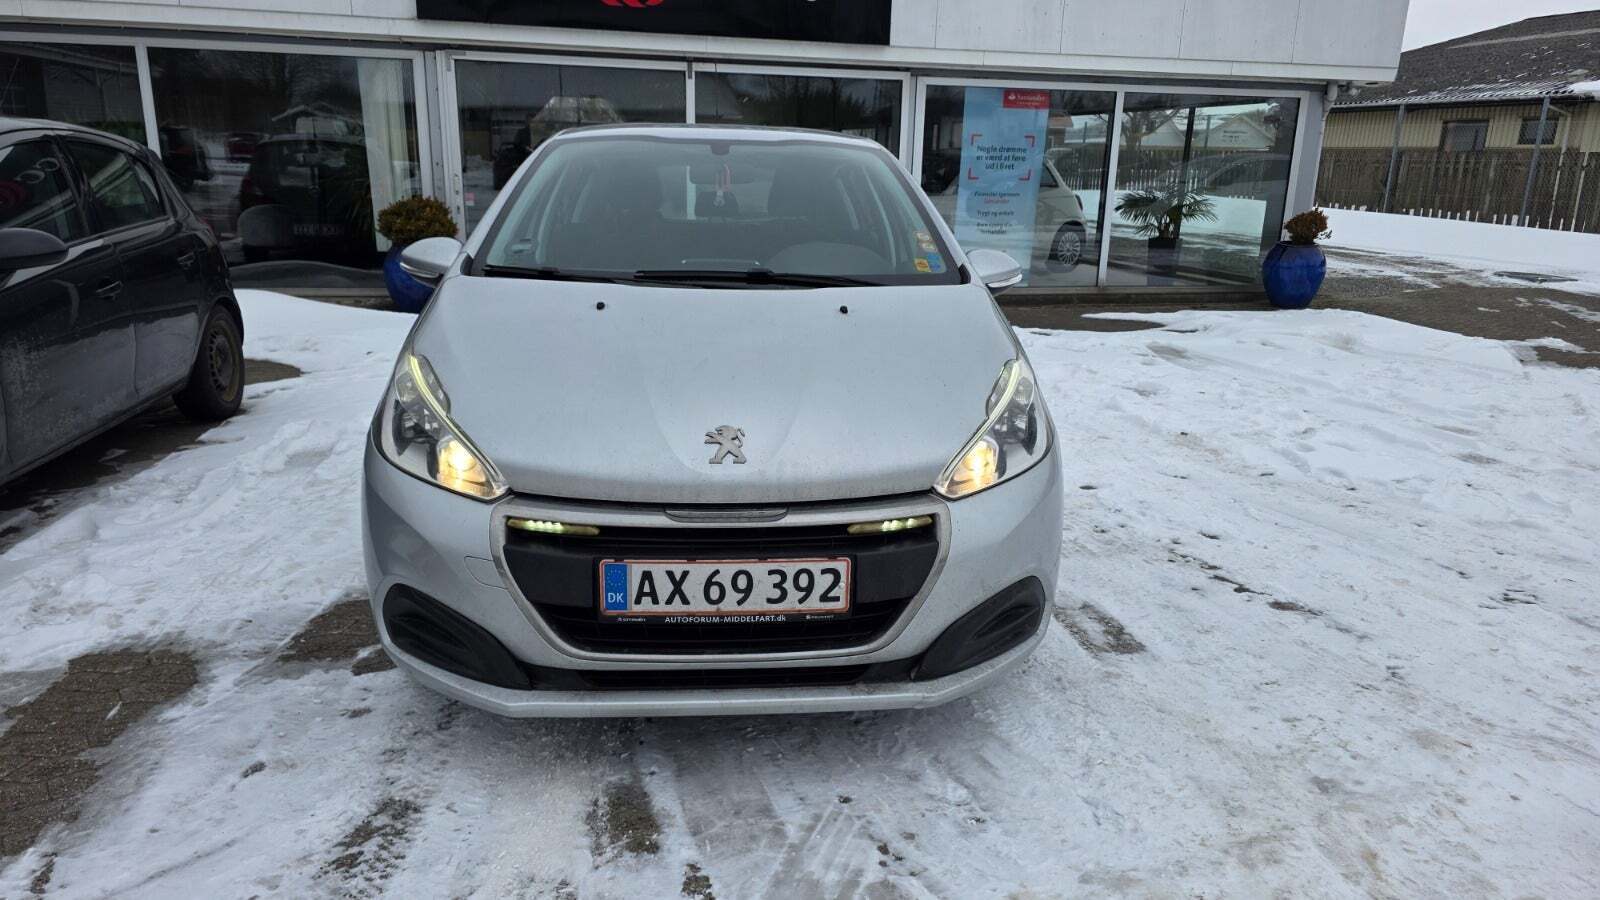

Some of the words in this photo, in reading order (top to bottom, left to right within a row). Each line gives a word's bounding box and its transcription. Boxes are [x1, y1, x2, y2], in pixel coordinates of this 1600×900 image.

[977, 144, 998, 154] Nogle
[999, 144, 1027, 154] drømme
[985, 161, 995, 170] ud
[634, 569, 691, 606] AX
[703, 568, 754, 607] 69
[766, 567, 842, 605] 392
[607, 592, 625, 604] DK
[664, 615, 786, 624] AUTOFORUM-MIDDELFART.dk
